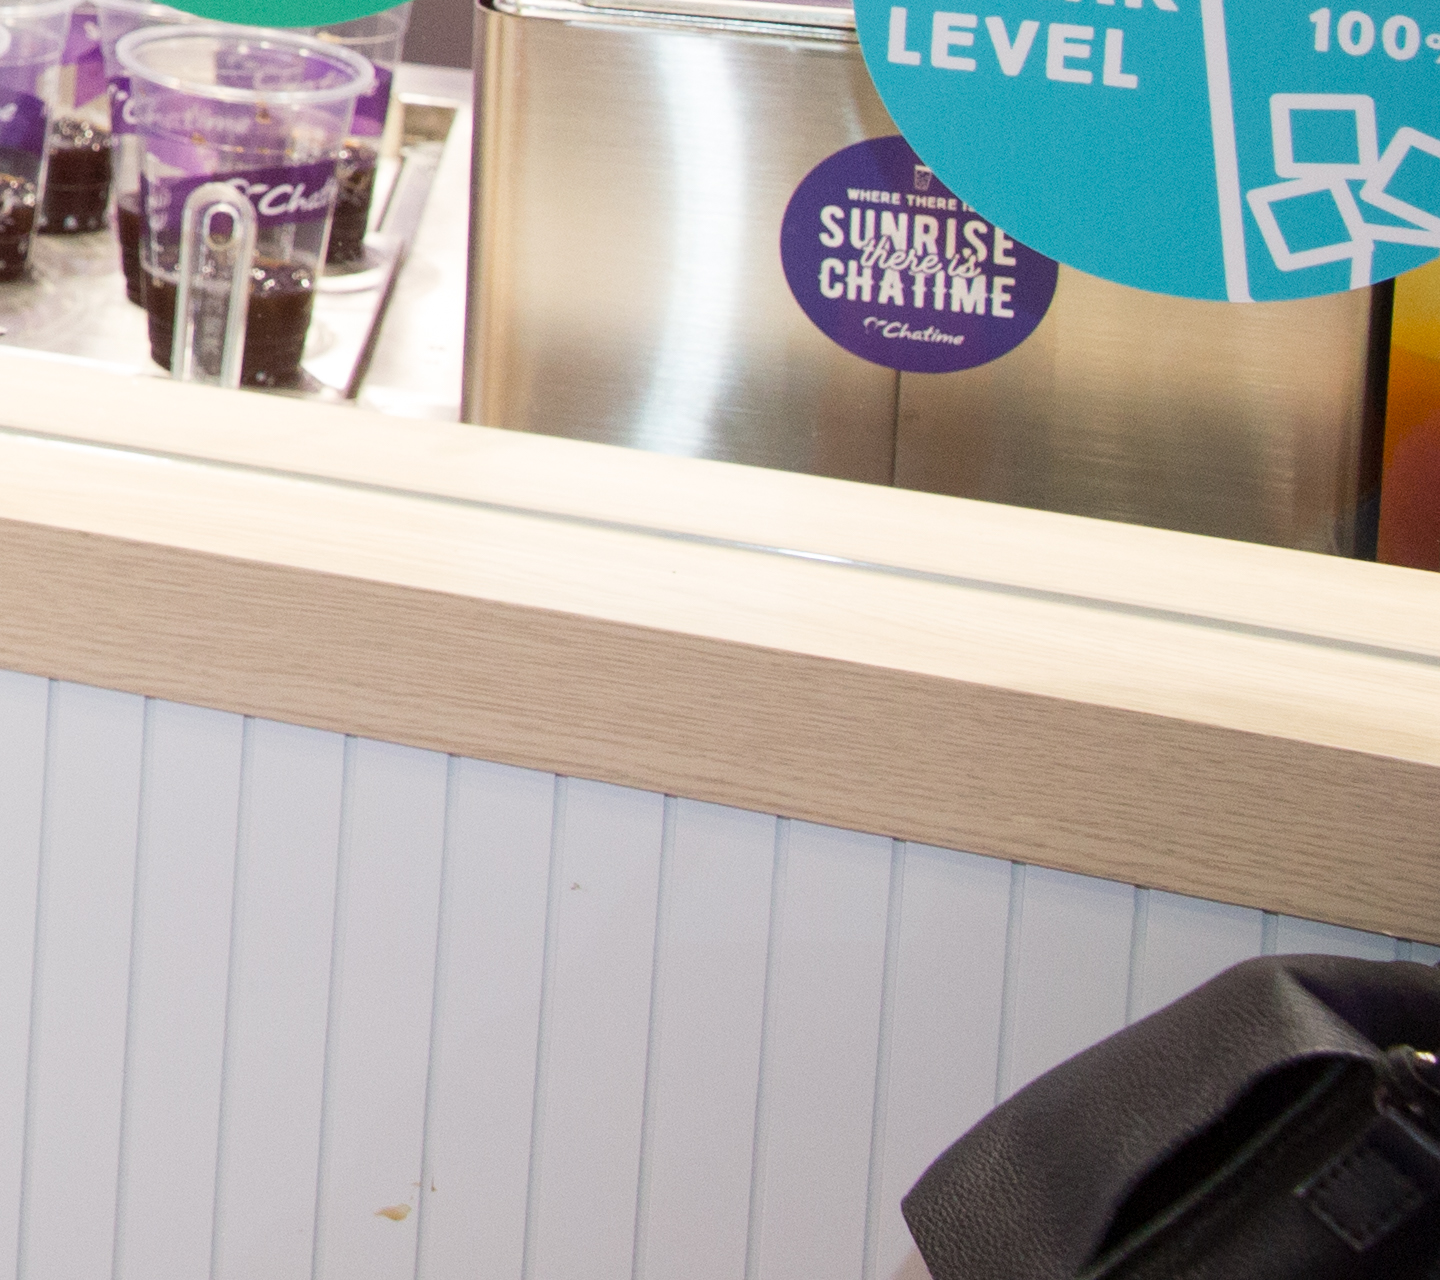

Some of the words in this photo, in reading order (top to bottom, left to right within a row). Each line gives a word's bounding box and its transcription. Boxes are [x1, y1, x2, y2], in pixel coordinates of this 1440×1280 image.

[886, 7, 1138, 89] LEVEL
[847, 188, 901, 206] WHERE
[906, 194, 958, 212] THERE
[819, 205, 1017, 266] SUNRISE
[860, 235, 942, 276] there
[947, 247, 982, 279] is
[818, 258, 1016, 319] CHATIME
[883, 321, 965, 346] Chatime
